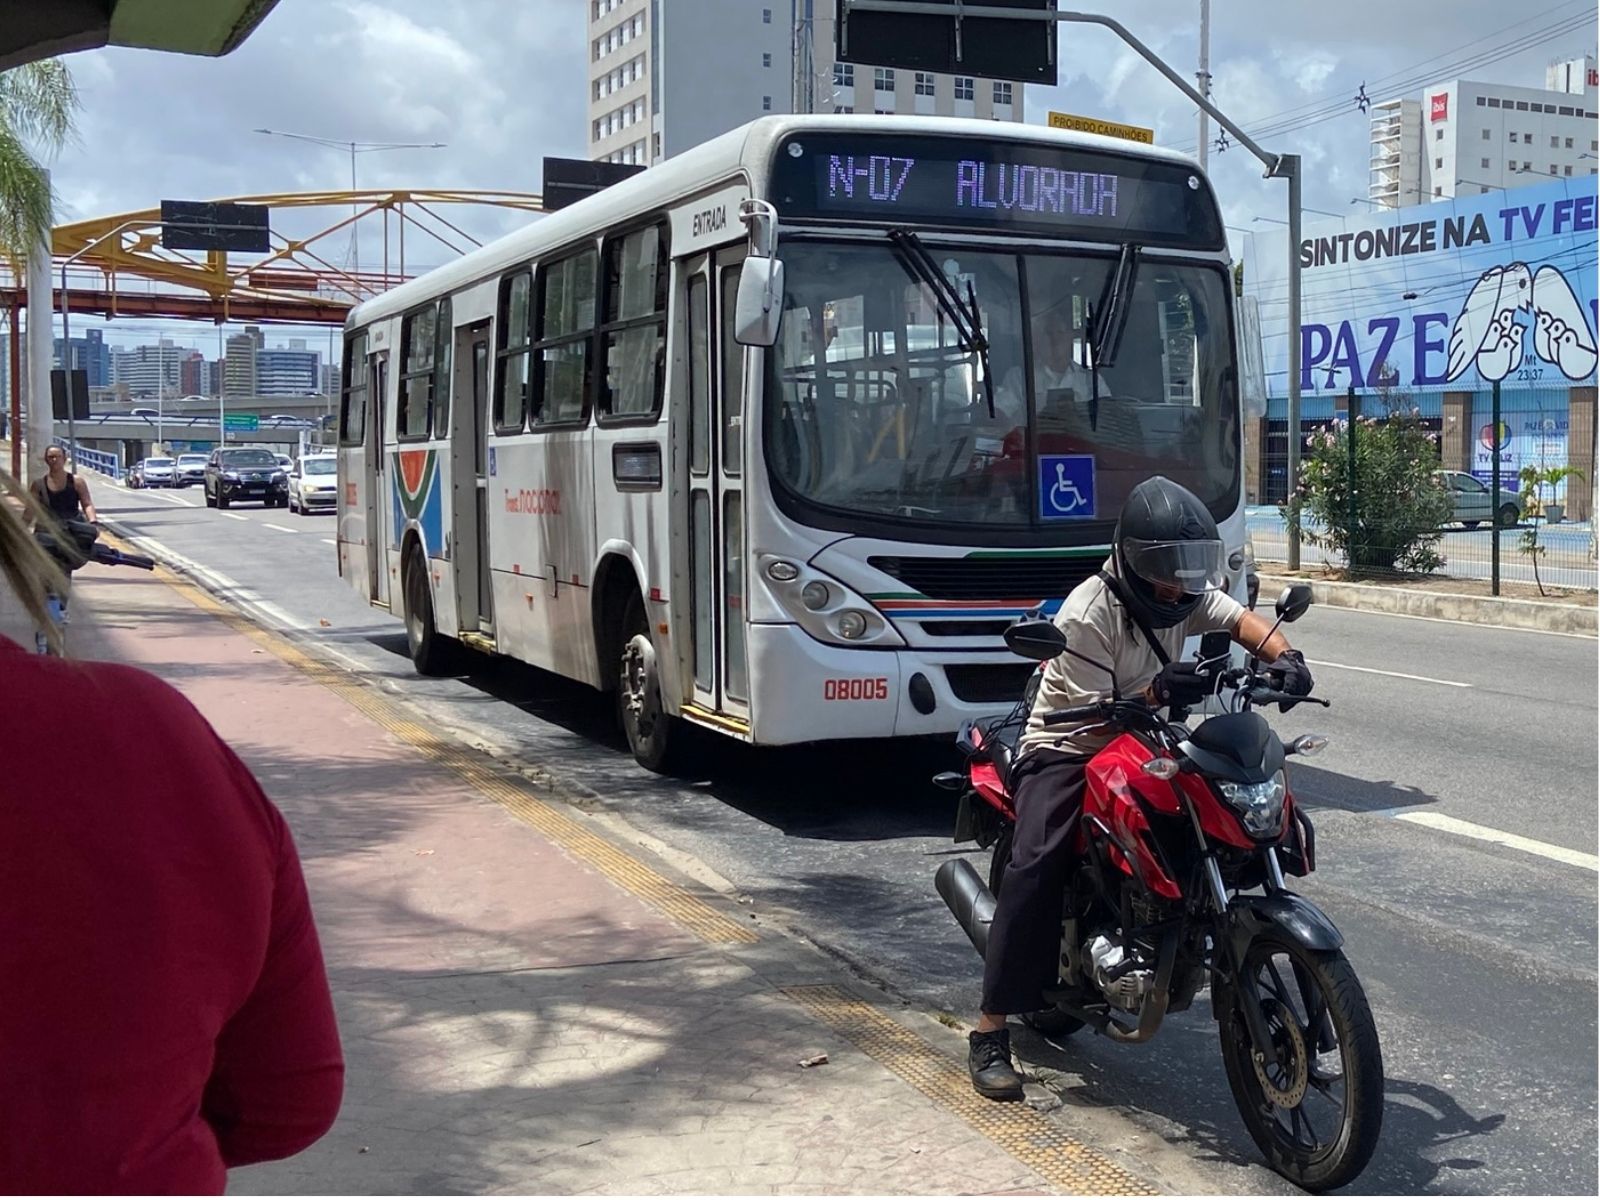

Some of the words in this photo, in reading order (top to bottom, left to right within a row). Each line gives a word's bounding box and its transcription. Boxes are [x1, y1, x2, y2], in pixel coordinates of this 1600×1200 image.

[1432, 101, 1445, 113] ibis
[1053, 115, 1096, 132] PROIBIDO
[1097, 123, 1148, 142] CAMINHÕES
[829, 154, 915, 201] N-07
[957, 160, 1118, 217] ALVORADA
[693, 204, 727, 237] ENTRADA
[1300, 220, 1437, 268] SINTONIZE
[1443, 213, 1491, 249] NA
[1499, 203, 1546, 241] TV
[1301, 317, 1401, 391] PAZ
[1411, 312, 1449, 387] E
[1525, 354, 1537, 366] Mt
[825, 678, 888, 700] 08005
